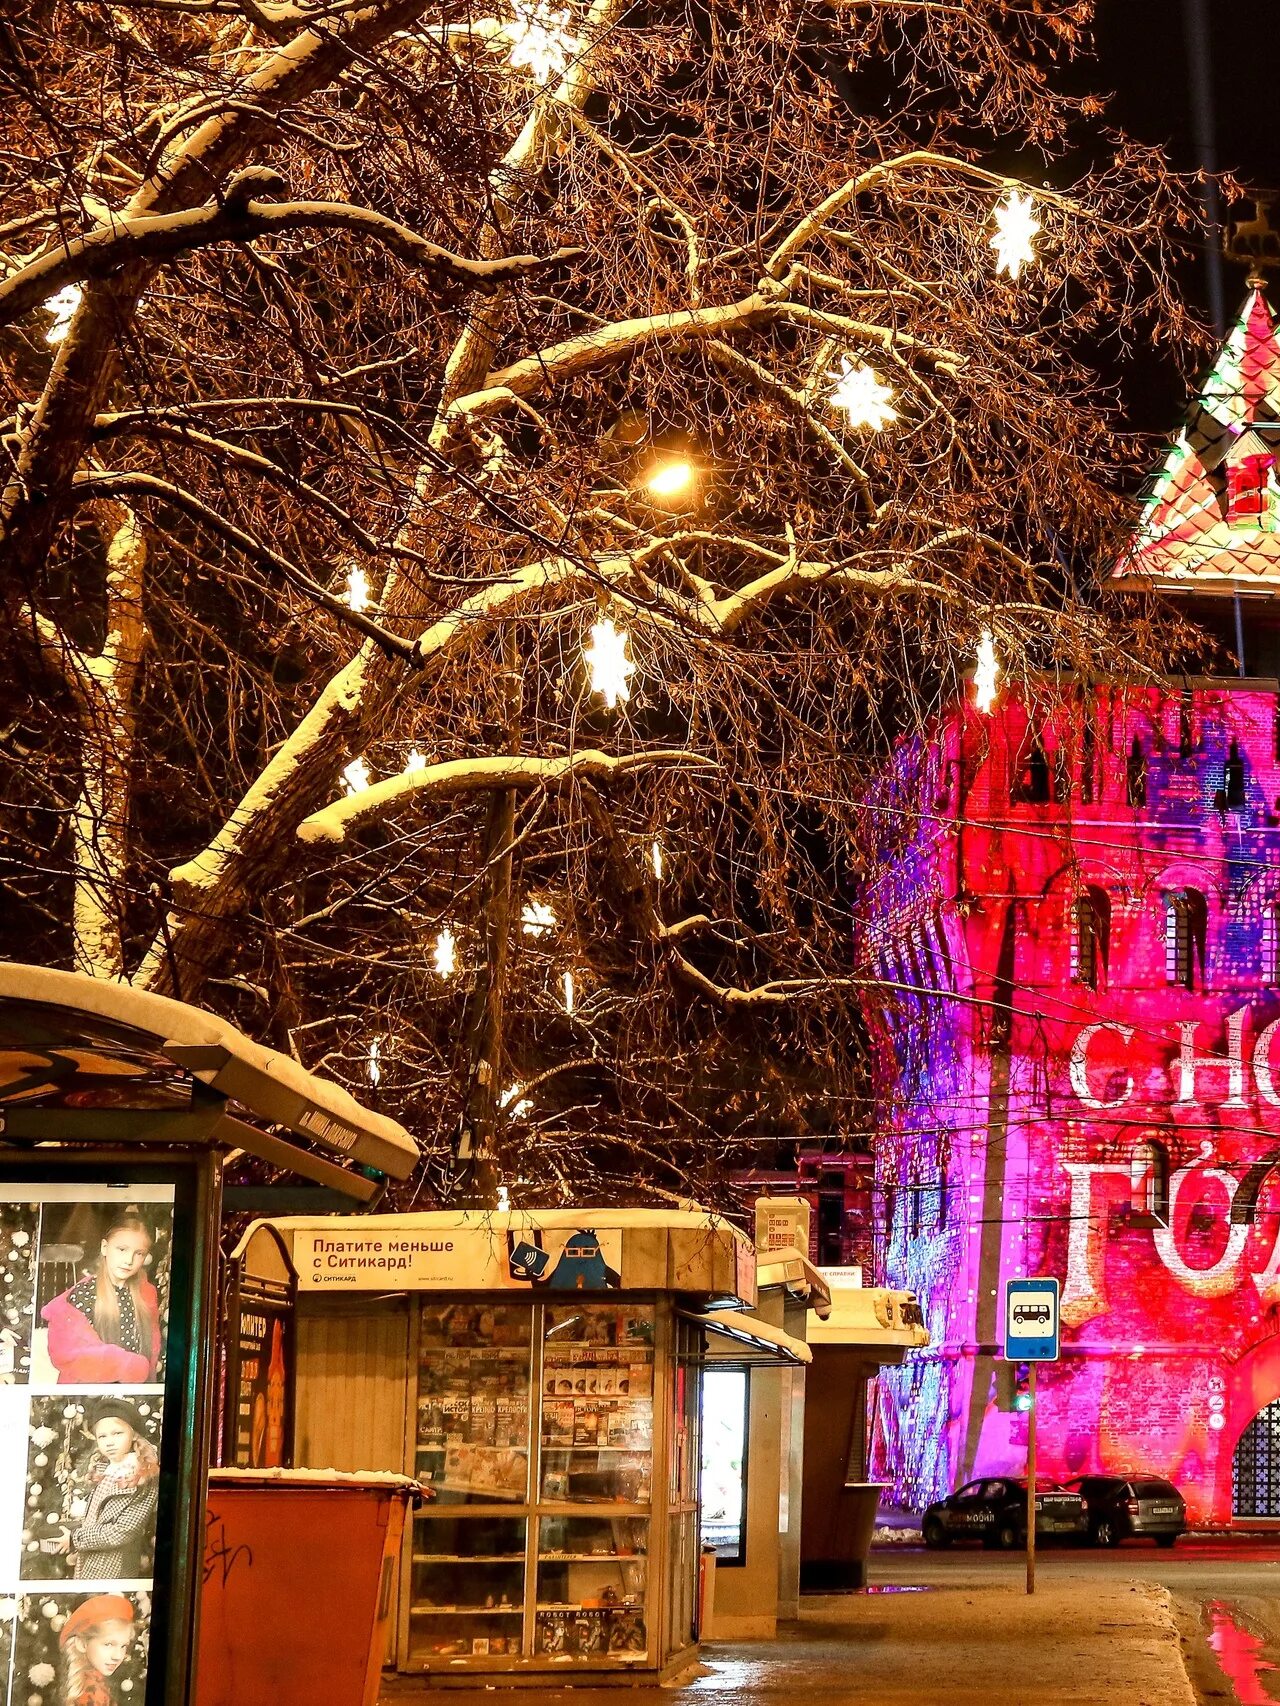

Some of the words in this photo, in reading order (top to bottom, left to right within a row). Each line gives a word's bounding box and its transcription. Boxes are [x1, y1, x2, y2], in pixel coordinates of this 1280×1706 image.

[1069, 1021, 1135, 1110] С
[313, 1239, 383, 1253] Платите
[388, 1241, 454, 1252] меньше
[313, 1257, 322, 1268] с
[327, 1254, 413, 1271] Ситикард!
